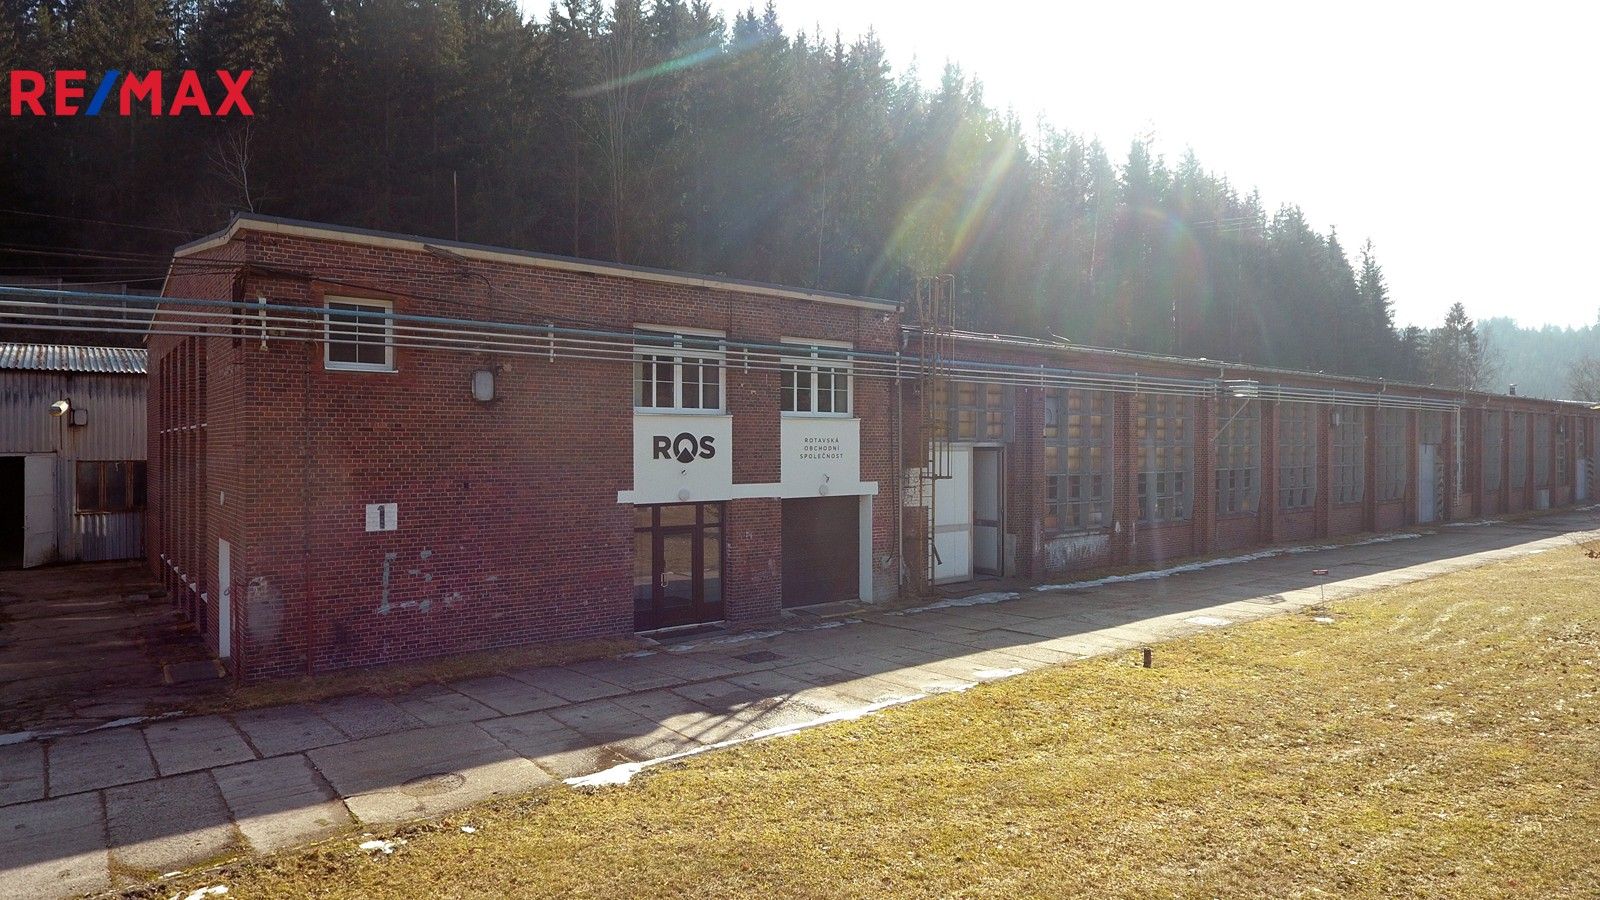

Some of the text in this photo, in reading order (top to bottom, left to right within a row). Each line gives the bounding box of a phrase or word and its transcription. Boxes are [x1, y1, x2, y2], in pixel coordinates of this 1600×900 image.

[653, 432, 716, 464] ROS
[799, 452, 843, 460] SPOLEČNOST
[377, 505, 385, 529] 1
